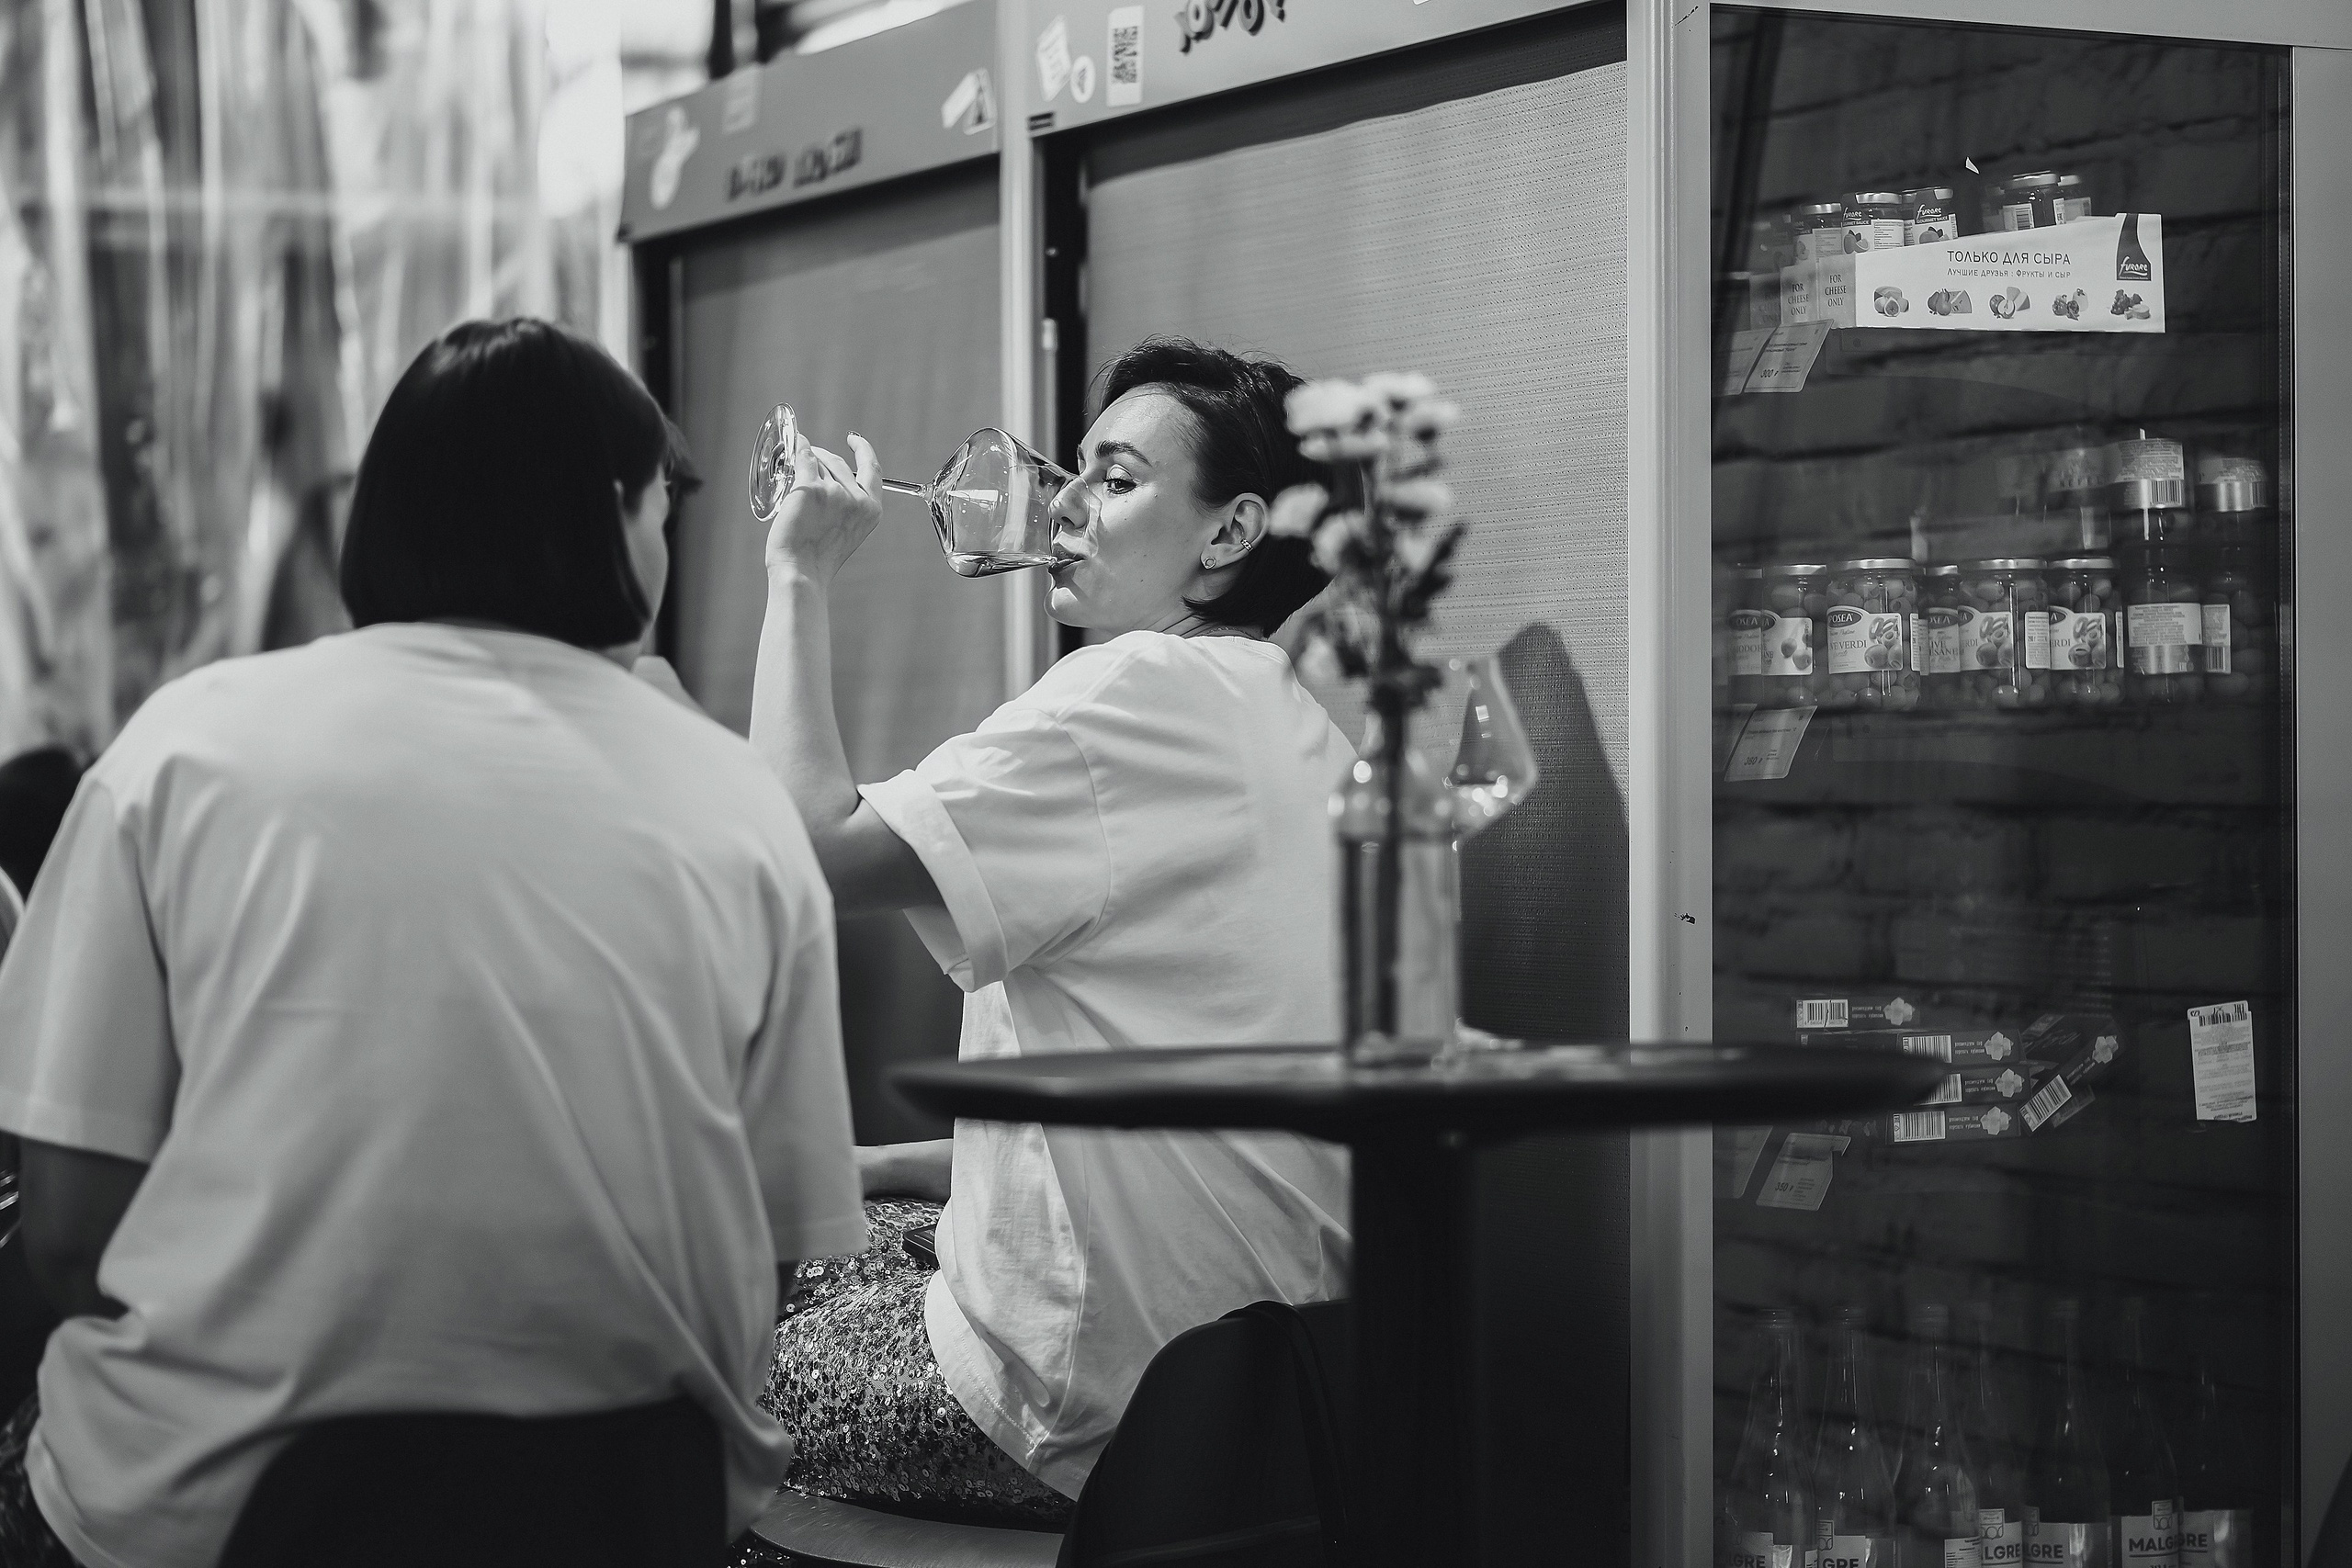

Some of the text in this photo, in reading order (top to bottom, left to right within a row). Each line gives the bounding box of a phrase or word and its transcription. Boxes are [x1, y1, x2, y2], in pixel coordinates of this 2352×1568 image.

[1947, 250, 2071, 265] ТОЛЬКО ДЛЯ СЫРА
[1947, 268, 1978, 276] ЛУЧШИЕ
[2016, 269, 2044, 277] ФРУКТЫ
[1829, 274, 1842, 284] FOR
[1792, 283, 1804, 293] FOR
[1825, 285, 1847, 296] CHEESE
[1788, 294, 1809, 305] CHEESE
[1827, 297, 1845, 308] ONLY
[1791, 306, 1807, 316] ONLY
[1829, 613, 1853, 623] OSEA
[1838, 639, 1867, 649] VERDI
[1775, 1182, 1789, 1191] 350
